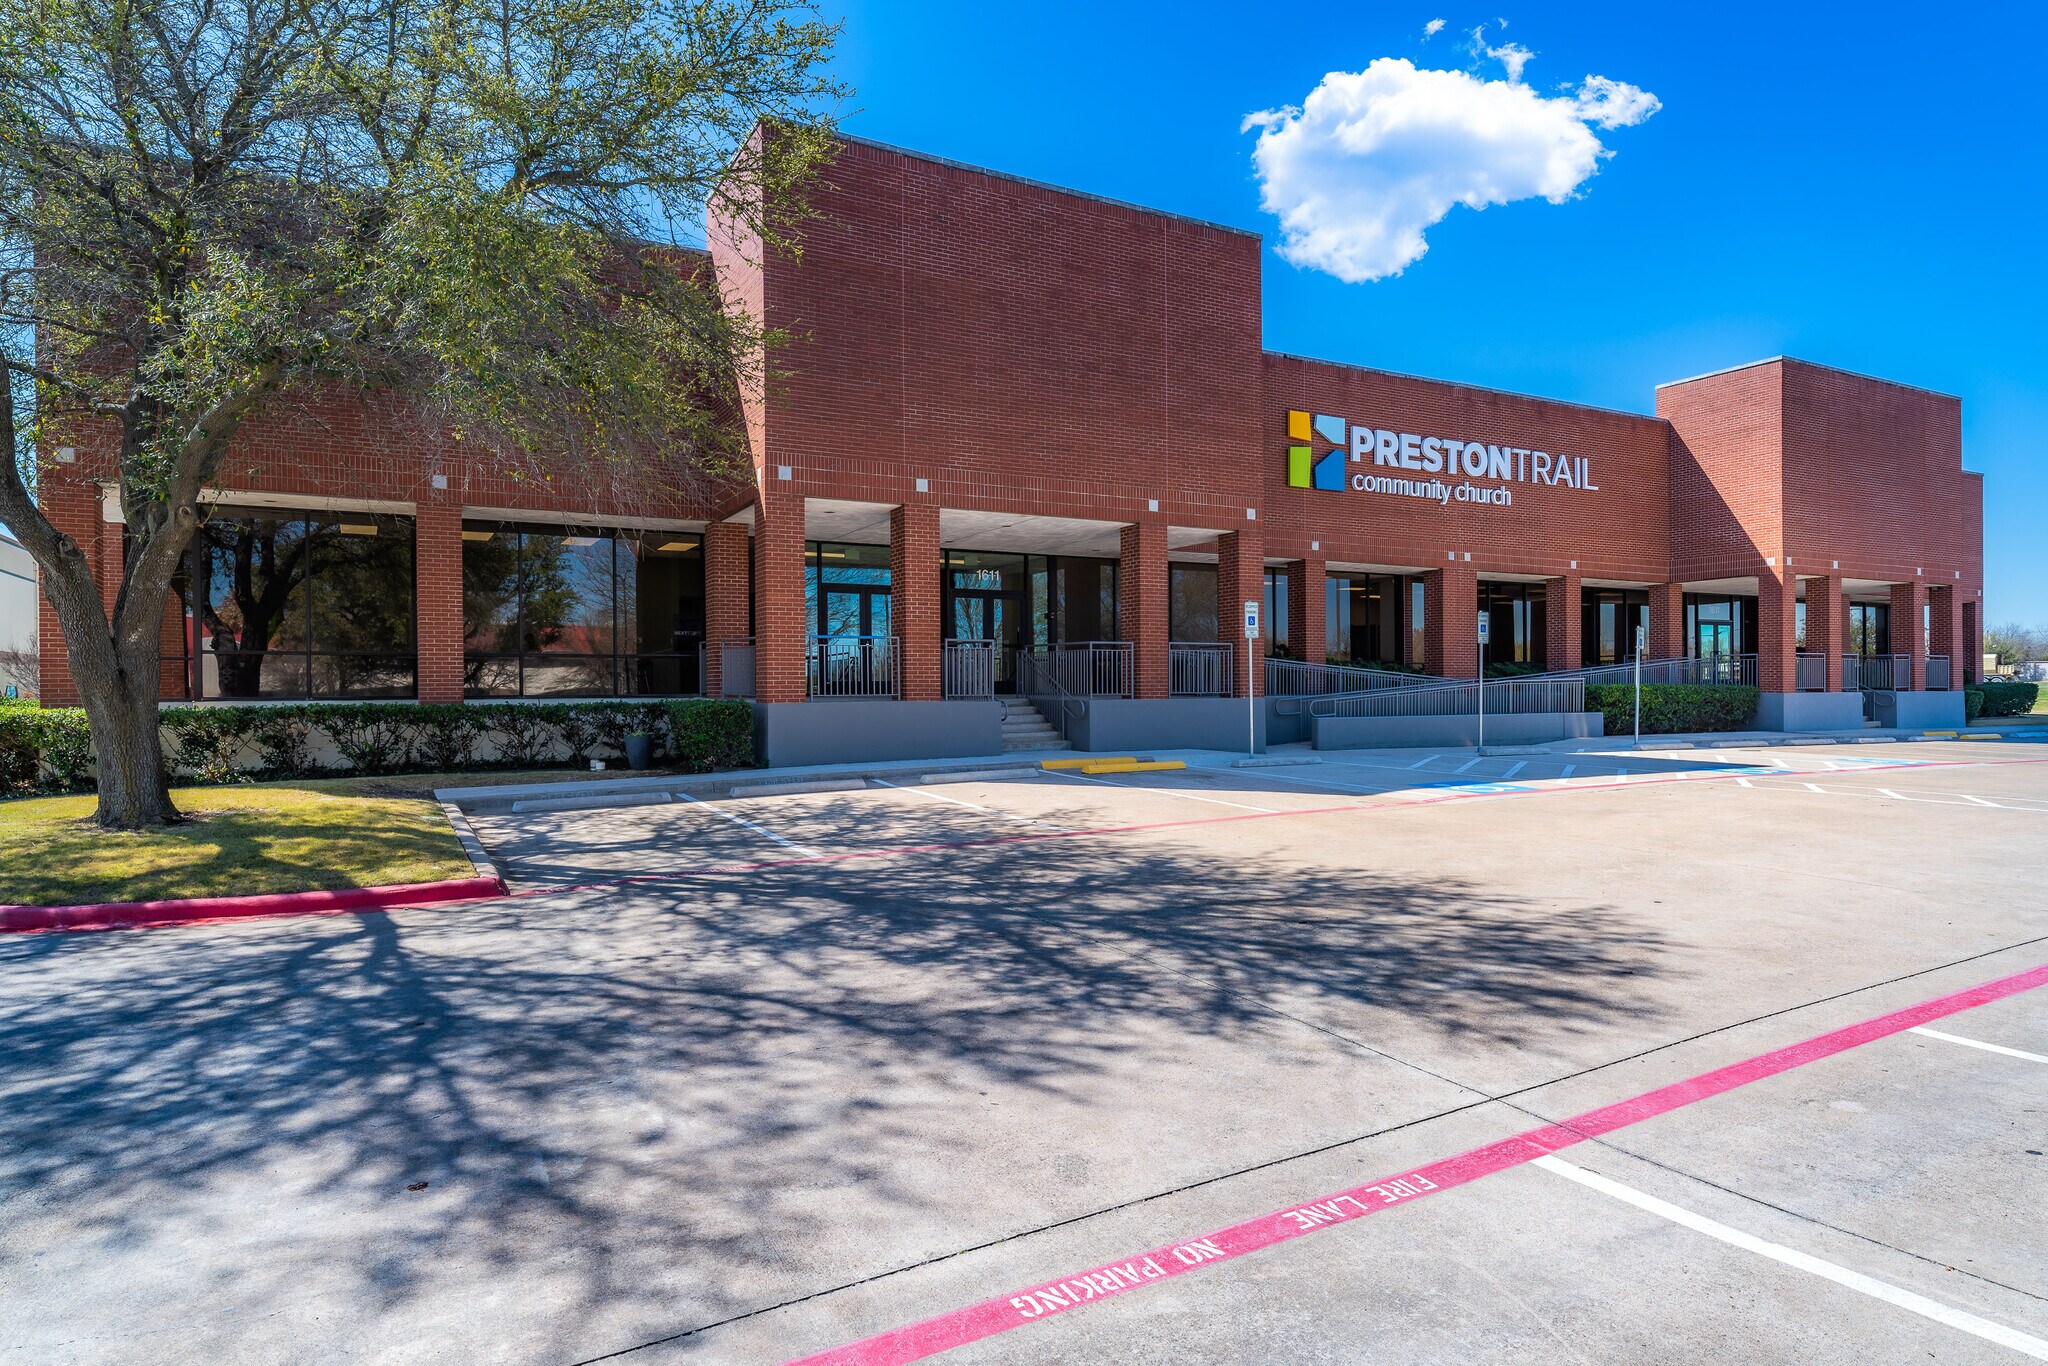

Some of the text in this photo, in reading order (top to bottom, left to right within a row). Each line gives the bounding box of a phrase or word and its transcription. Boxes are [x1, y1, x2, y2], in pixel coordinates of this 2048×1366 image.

[1351, 474, 1512, 506] community church
[976, 569, 1000, 581] 1611
[1008, 1173, 1439, 1318] FIRE LANE NO PARKING
